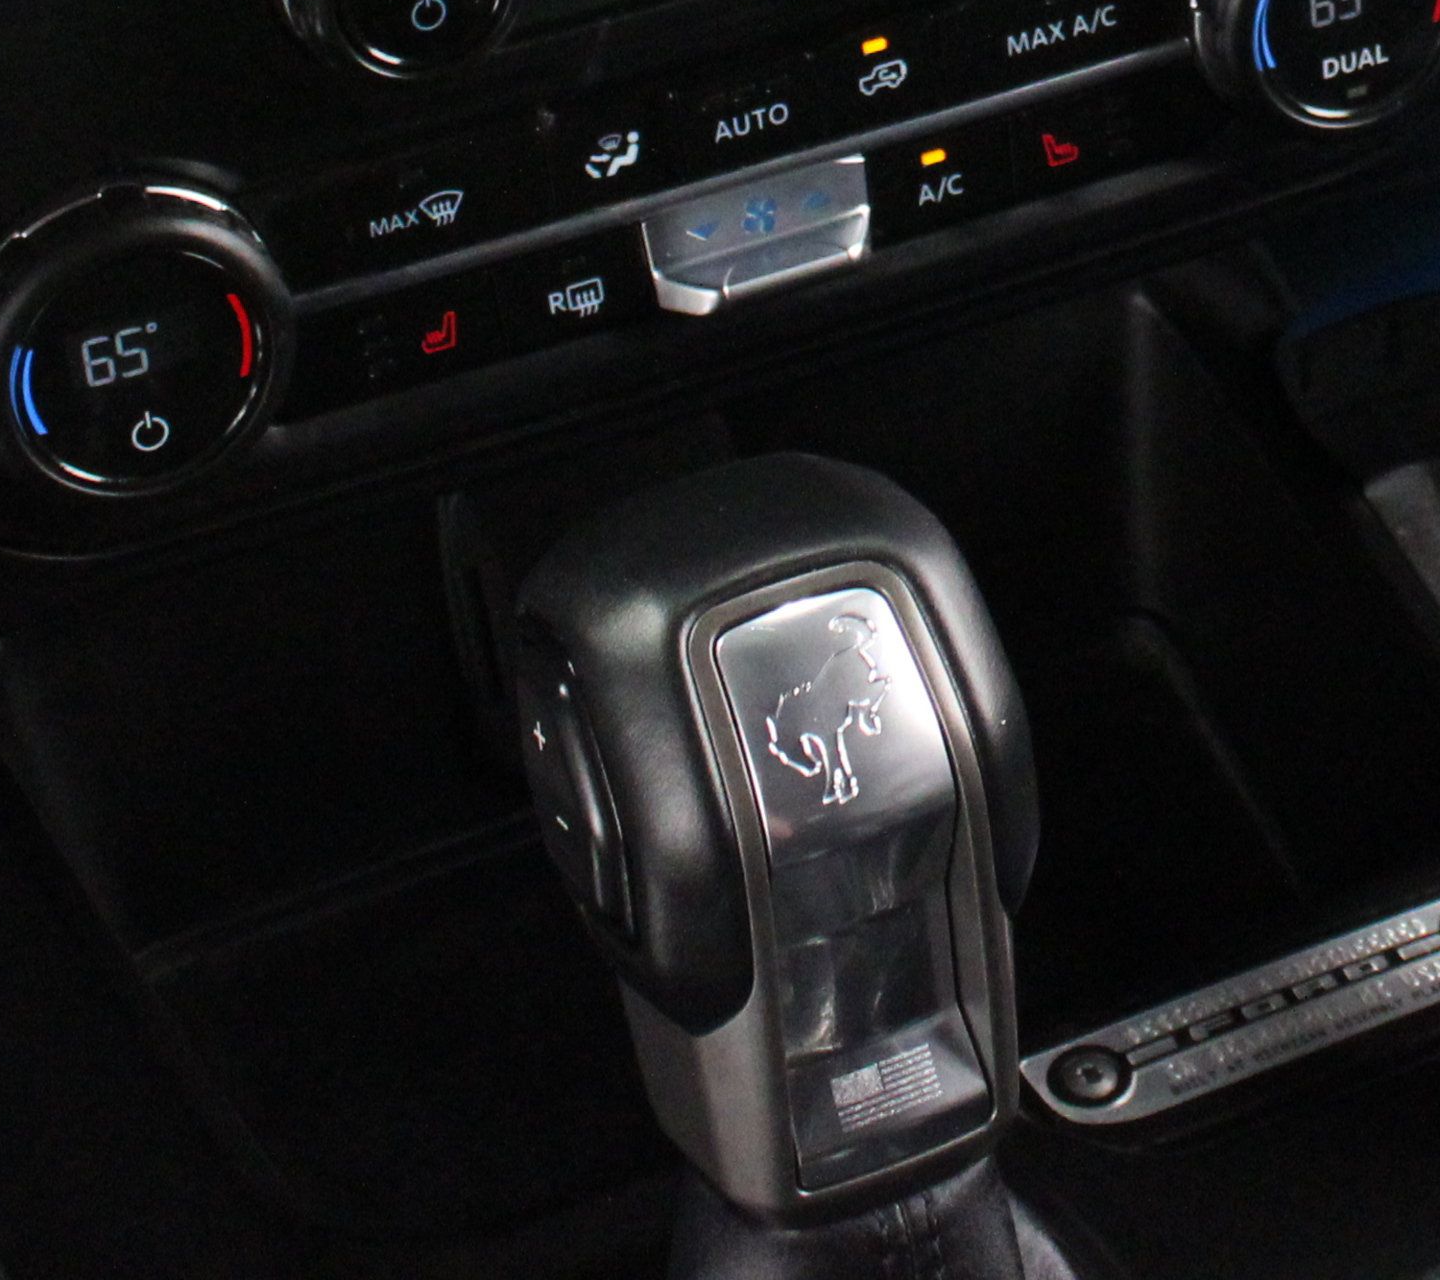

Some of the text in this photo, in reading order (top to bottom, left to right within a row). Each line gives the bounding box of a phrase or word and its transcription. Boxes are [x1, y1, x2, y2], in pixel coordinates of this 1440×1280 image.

[1007, 5, 1116, 55] MAX A/C
[1322, 44, 1389, 79] DUAL
[716, 103, 788, 142] AUTO
[919, 173, 963, 206] A/C
[370, 209, 419, 237] MAX
[548, 292, 566, 314] R
